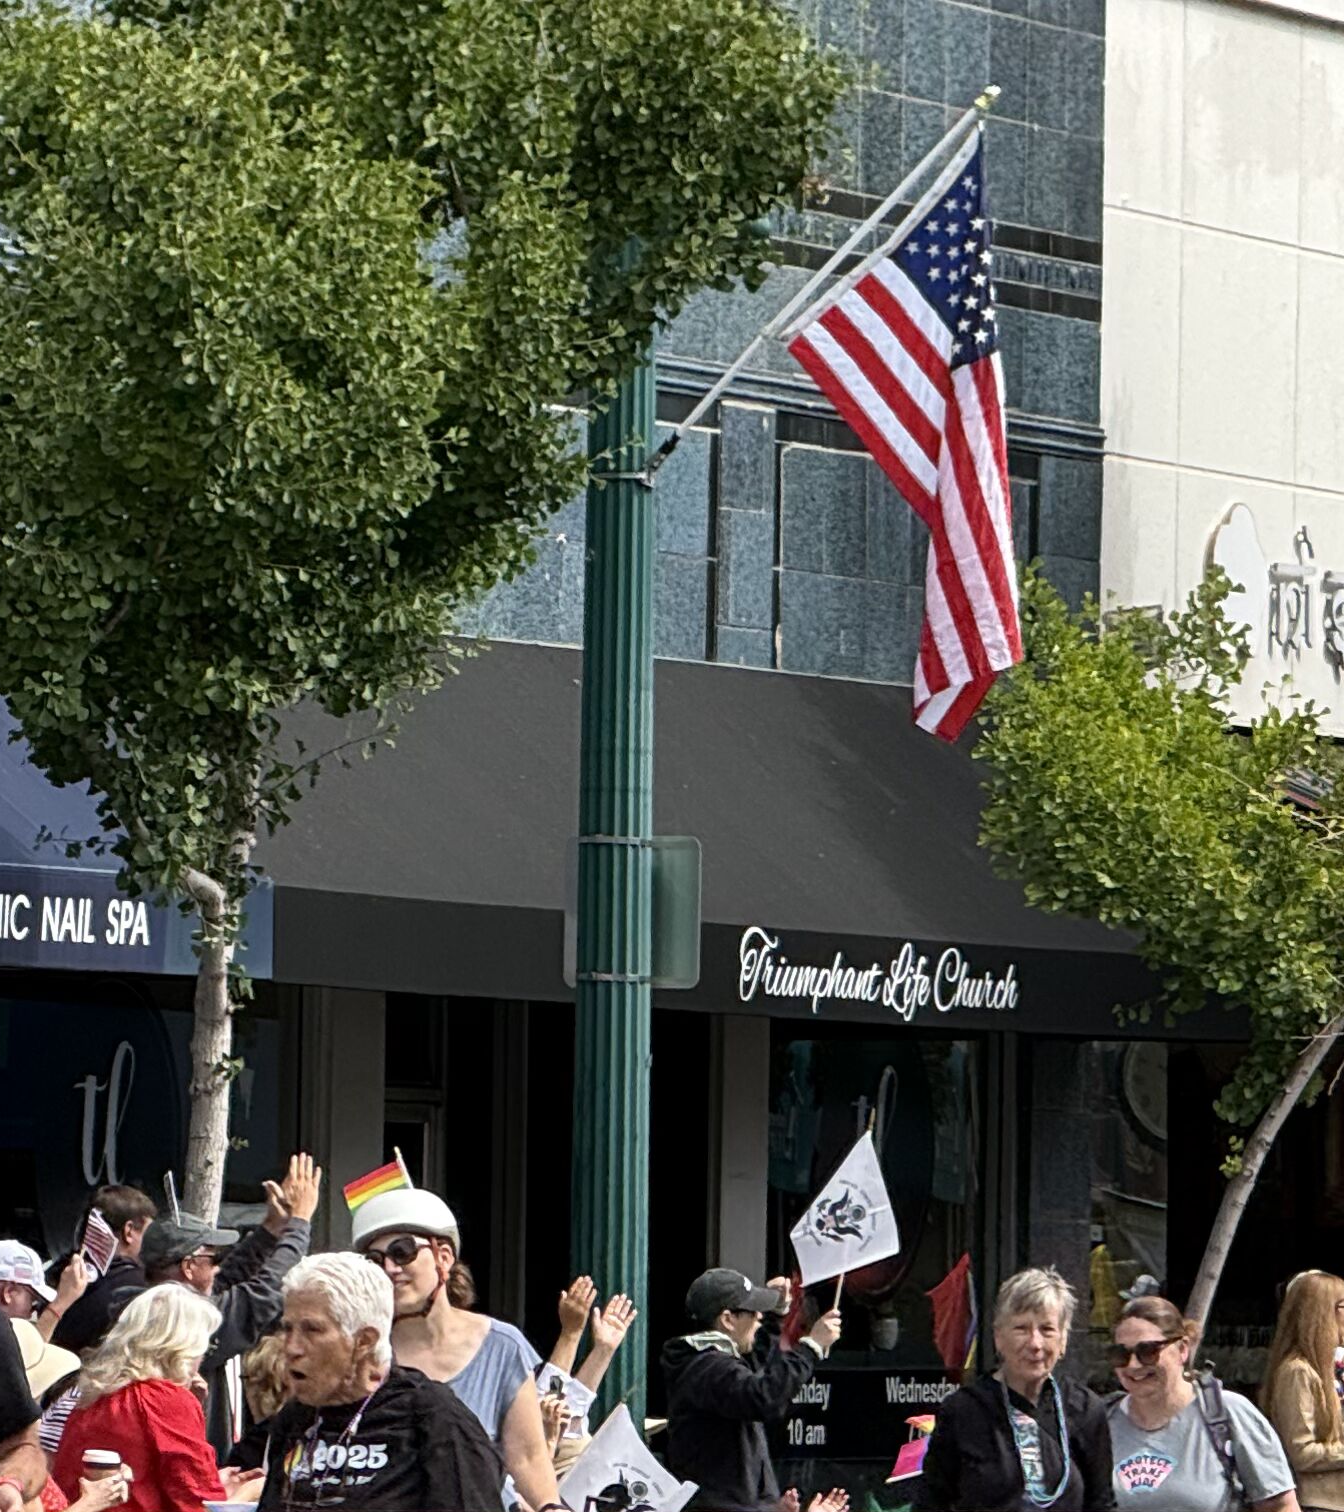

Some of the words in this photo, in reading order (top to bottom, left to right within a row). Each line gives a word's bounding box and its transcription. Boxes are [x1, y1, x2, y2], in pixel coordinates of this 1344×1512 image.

[41, 895, 96, 944] NAIL
[106, 899, 150, 946] SPA
[739, 926, 885, 1014] Triumphant
[882, 942, 931, 1022] Life
[934, 947, 1019, 1011] Church
[792, 1376, 831, 1411] nday
[787, 1417, 803, 1445] 10
[805, 1423, 826, 1446] am
[312, 1443, 389, 1471] 2025
[1119, 1454, 1172, 1471] PROTECT
[1124, 1466, 1164, 1479] TRANS
